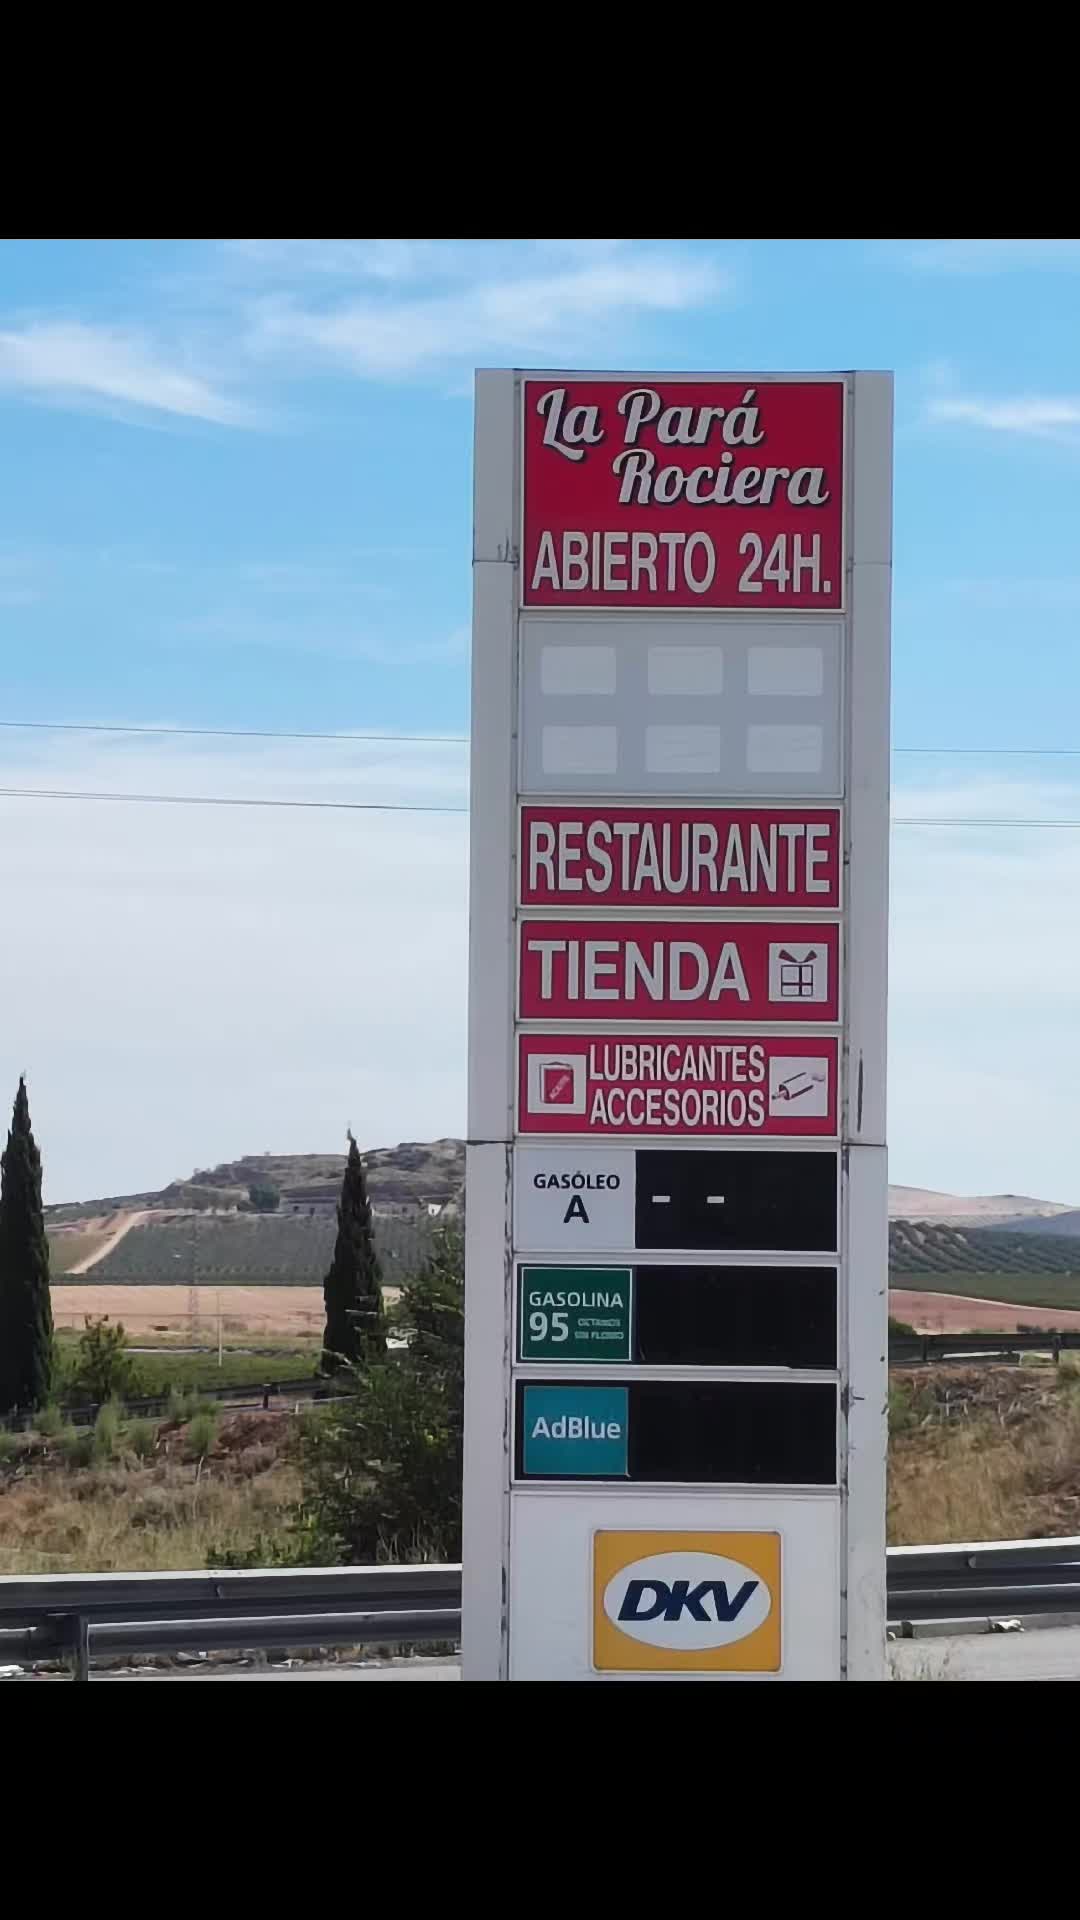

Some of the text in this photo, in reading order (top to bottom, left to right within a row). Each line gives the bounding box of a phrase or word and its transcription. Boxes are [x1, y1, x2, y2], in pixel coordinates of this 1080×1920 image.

[536, 388, 764, 460] La Pará
[612, 448, 829, 504] Rociera
[531, 531, 832, 593] ABIERTO 24H.
[529, 820, 831, 893] RESTAURANTE
[527, 941, 750, 1001] TIENDA
[589, 1044, 765, 1083] LUBRICANTES
[590, 1088, 765, 1127] ACCESORIOS
[533, 1171, 620, 1190] GASÓLEO
[563, 1194, 590, 1224] A
[529, 1292, 624, 1308] GASOLINA
[529, 1312, 569, 1342] 95
[531, 1416, 621, 1439] AdBlue
[617, 1579, 759, 1622] DKV
